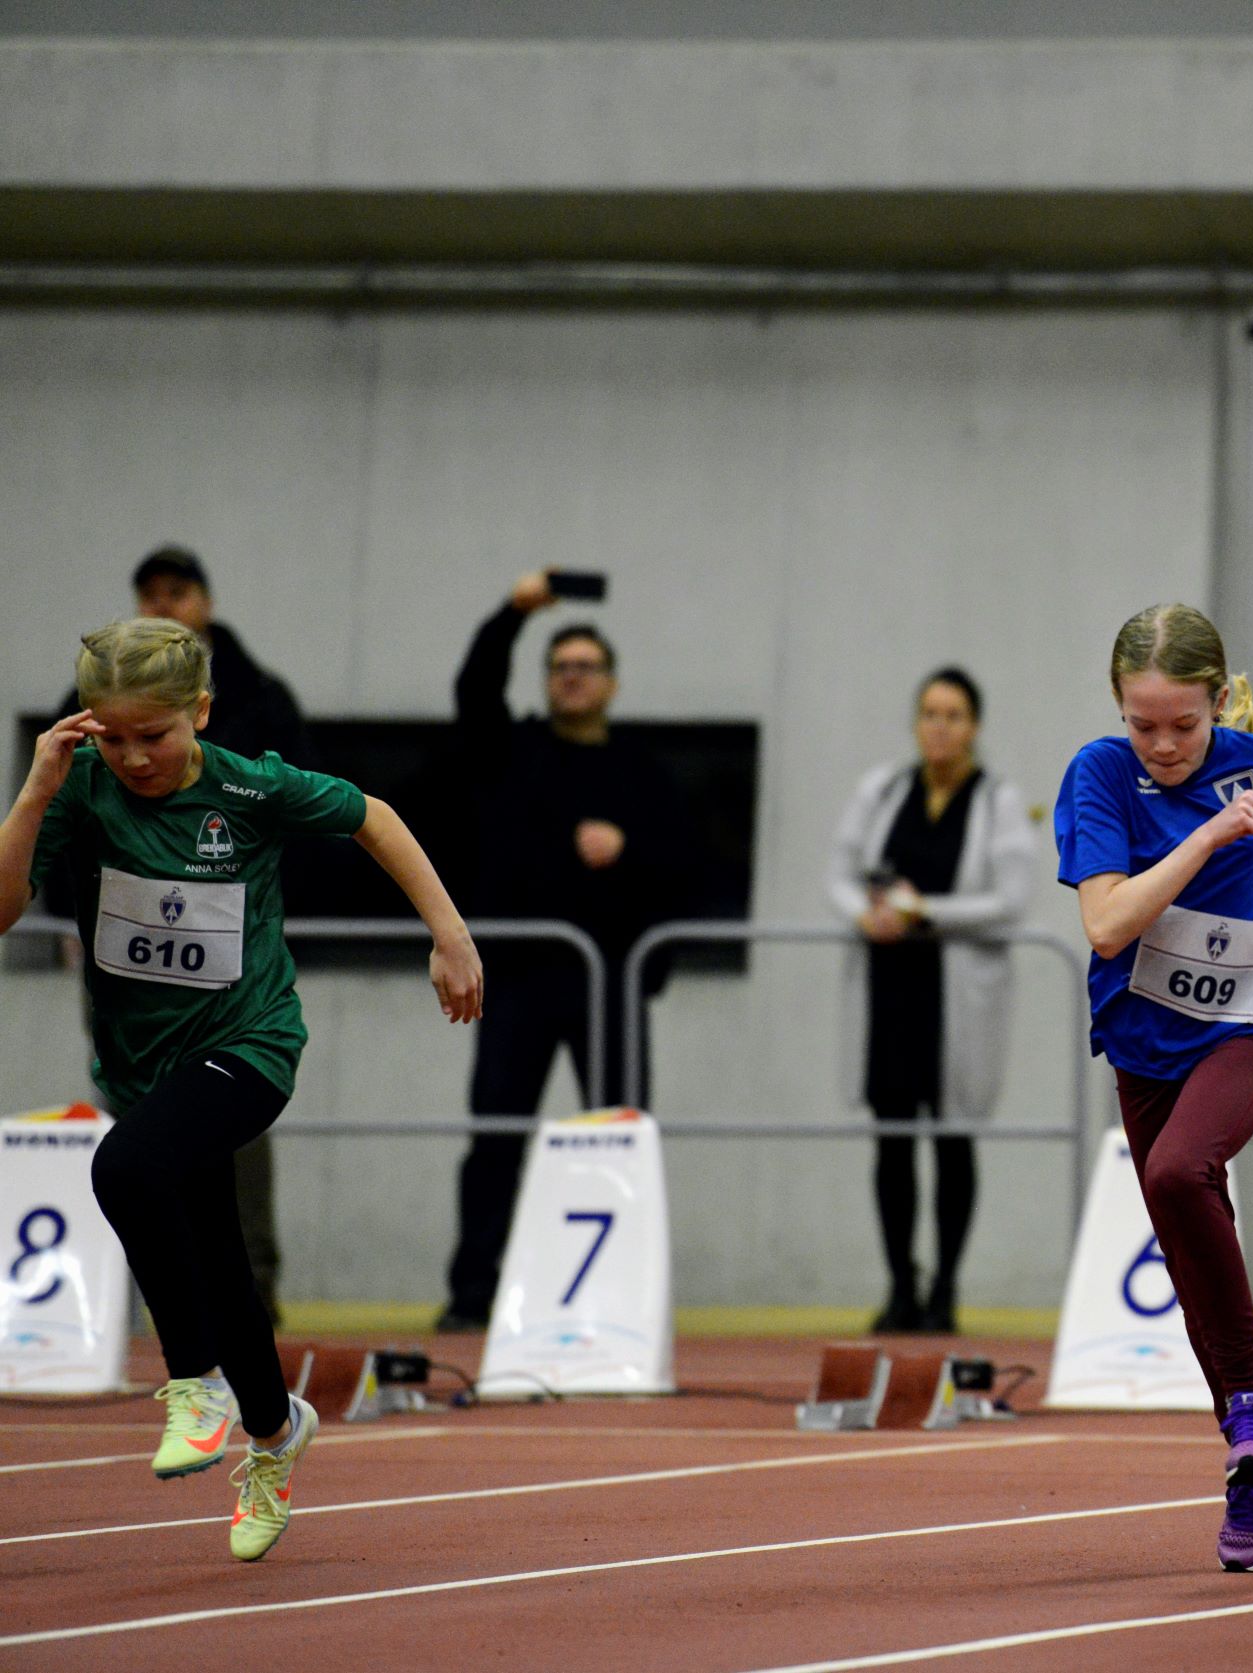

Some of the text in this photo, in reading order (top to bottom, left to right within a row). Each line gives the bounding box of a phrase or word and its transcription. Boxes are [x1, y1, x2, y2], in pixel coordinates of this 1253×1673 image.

[222, 783, 257, 798] CRAFT
[184, 864, 213, 873] ANNA
[127, 936, 205, 971] 610
[1168, 969, 1236, 1006] 609
[10, 1206, 67, 1305] 8
[562, 1210, 615, 1306] 7
